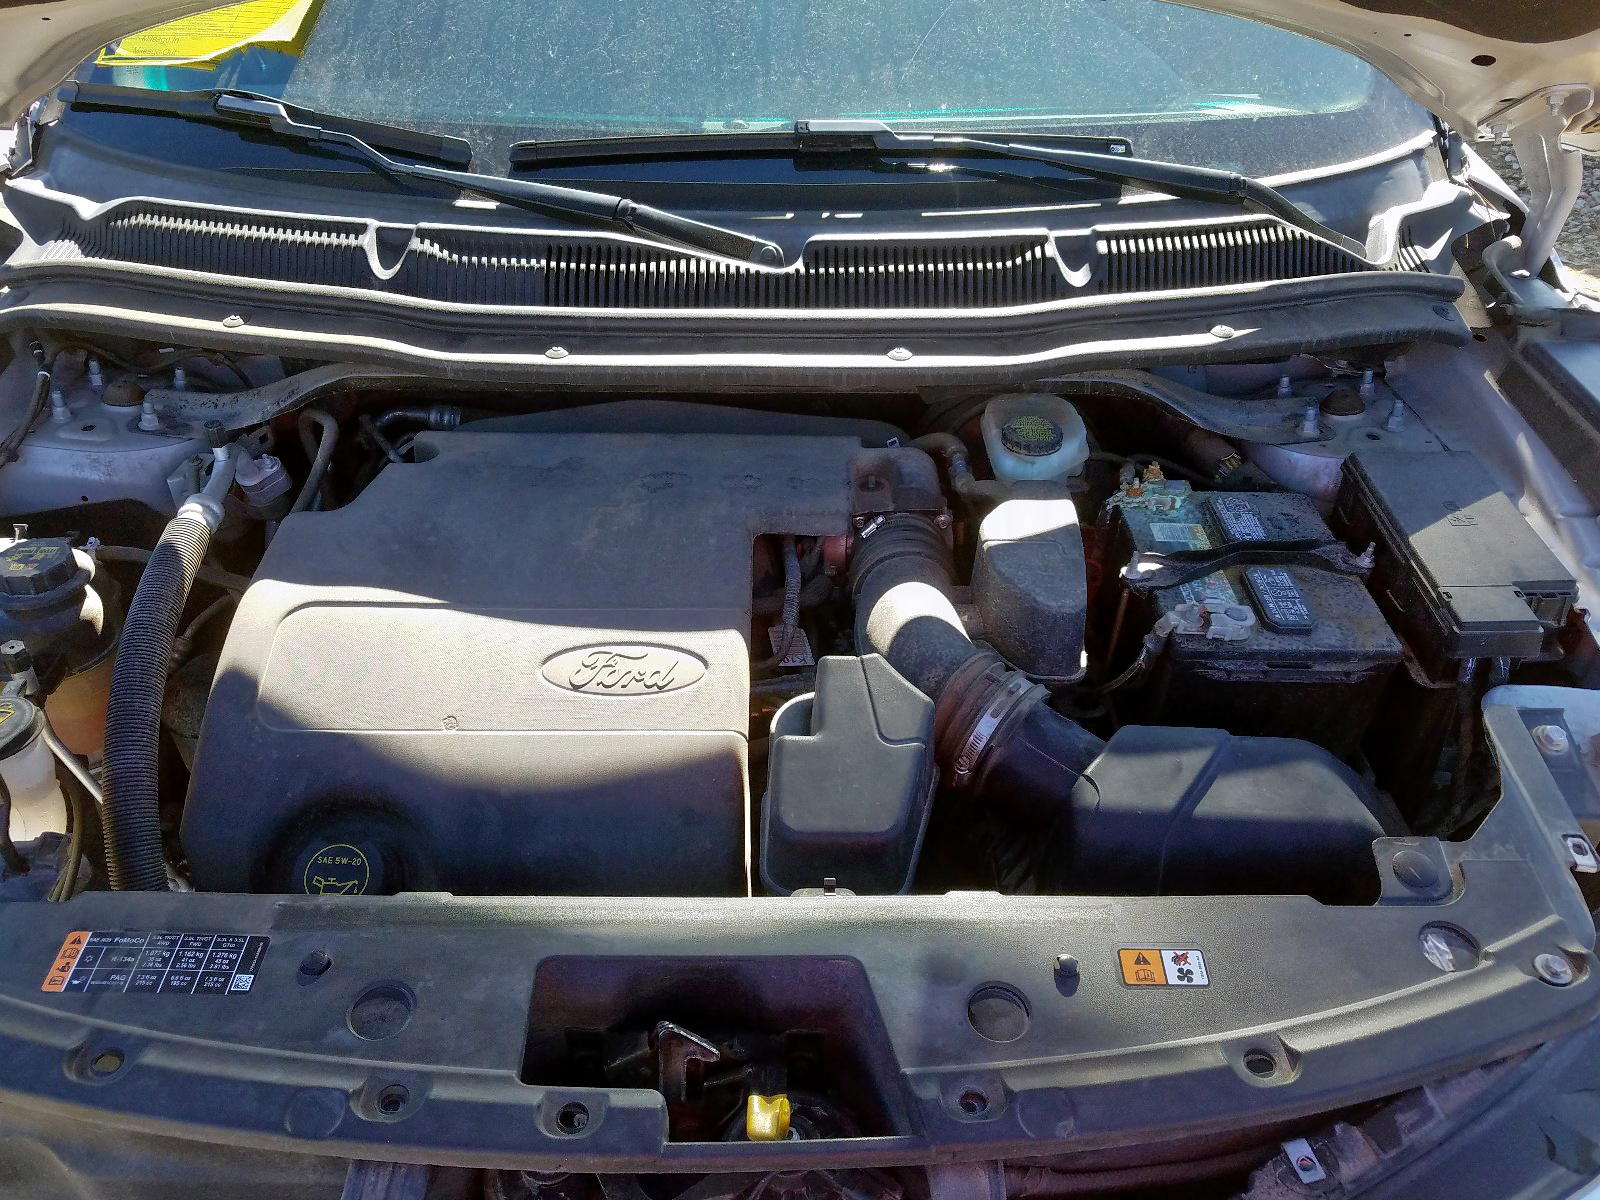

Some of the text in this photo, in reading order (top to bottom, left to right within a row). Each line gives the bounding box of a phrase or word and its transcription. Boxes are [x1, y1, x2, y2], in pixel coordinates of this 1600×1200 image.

[568, 651, 680, 690] Ford
[317, 856, 362, 866] SAE 5W-20
[162, 950, 171, 958] kg
[229, 952, 238, 960] kg
